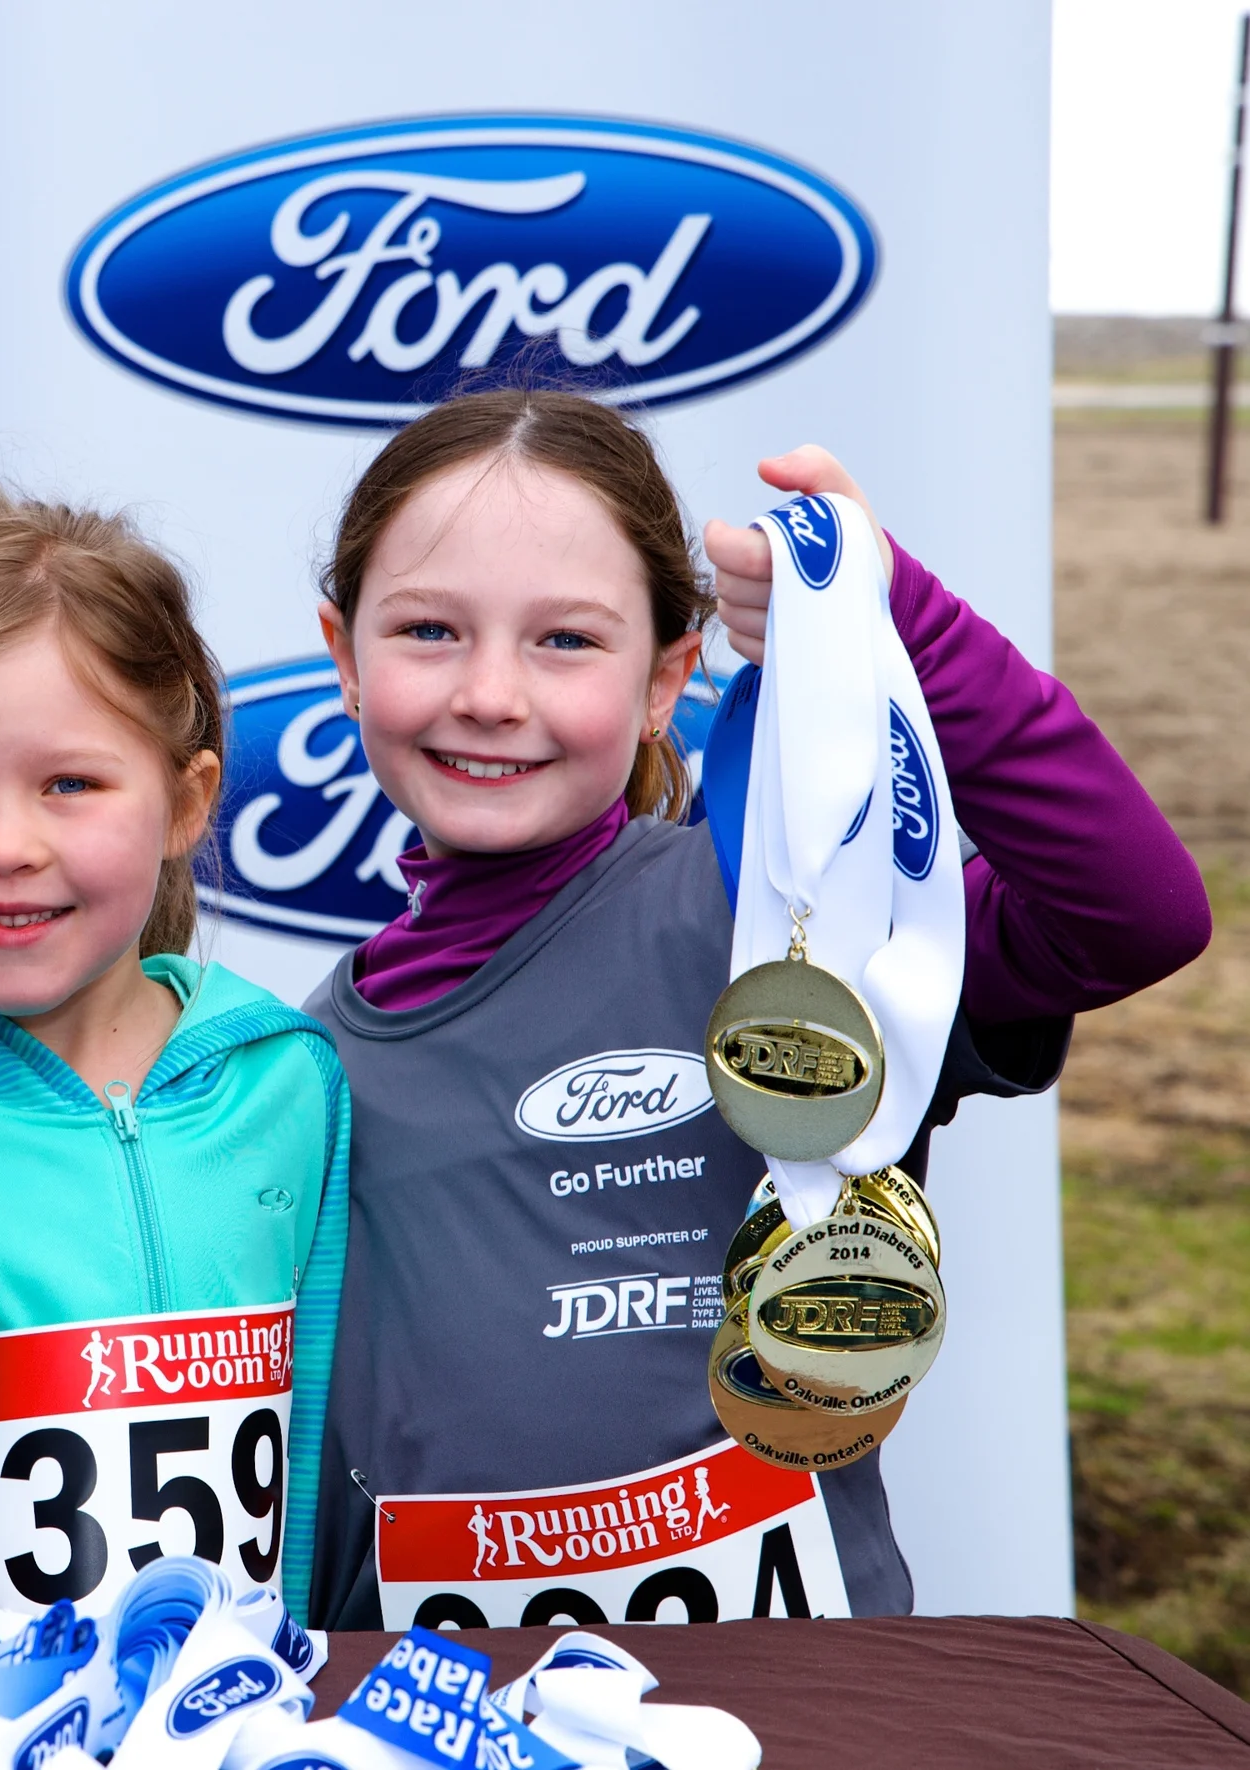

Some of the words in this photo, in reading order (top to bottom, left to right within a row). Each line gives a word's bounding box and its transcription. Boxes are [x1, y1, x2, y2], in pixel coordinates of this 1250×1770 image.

[223, 170, 713, 375] Ford
[730, 1039, 820, 1078] JDRF
[556, 1065, 678, 1127] Ford
[550, 1170, 590, 1197] Go
[595, 1155, 706, 1190] Further
[571, 1238, 614, 1256] PROUD
[616, 1230, 690, 1249] SUPPORTER
[691, 1228, 710, 1242] OF
[772, 1240, 807, 1273] Race
[806, 1230, 825, 1245] to
[827, 1222, 860, 1238] End
[862, 1223, 925, 1270] Diabetes
[829, 1246, 871, 1261] 2014
[693, 1275, 724, 1286] IMPRO
[693, 1286, 721, 1297] LIVES.
[543, 1276, 691, 1338] JDRF
[692, 1308, 715, 1318] TYPE
[716, 1308, 723, 1318] 1
[772, 1301, 881, 1332] JDRF
[116, 1317, 284, 1394] Running
[784, 1378, 848, 1410] Oakville
[850, 1374, 912, 1409] Ontario
[744, 1432, 810, 1466] Oakville
[813, 1432, 875, 1466] Ontario
[0, 1407, 283, 1606] 359
[495, 1475, 690, 1567] Running
[184, 1671, 266, 1717] Ford
[366, 1678, 476, 1762] Race
